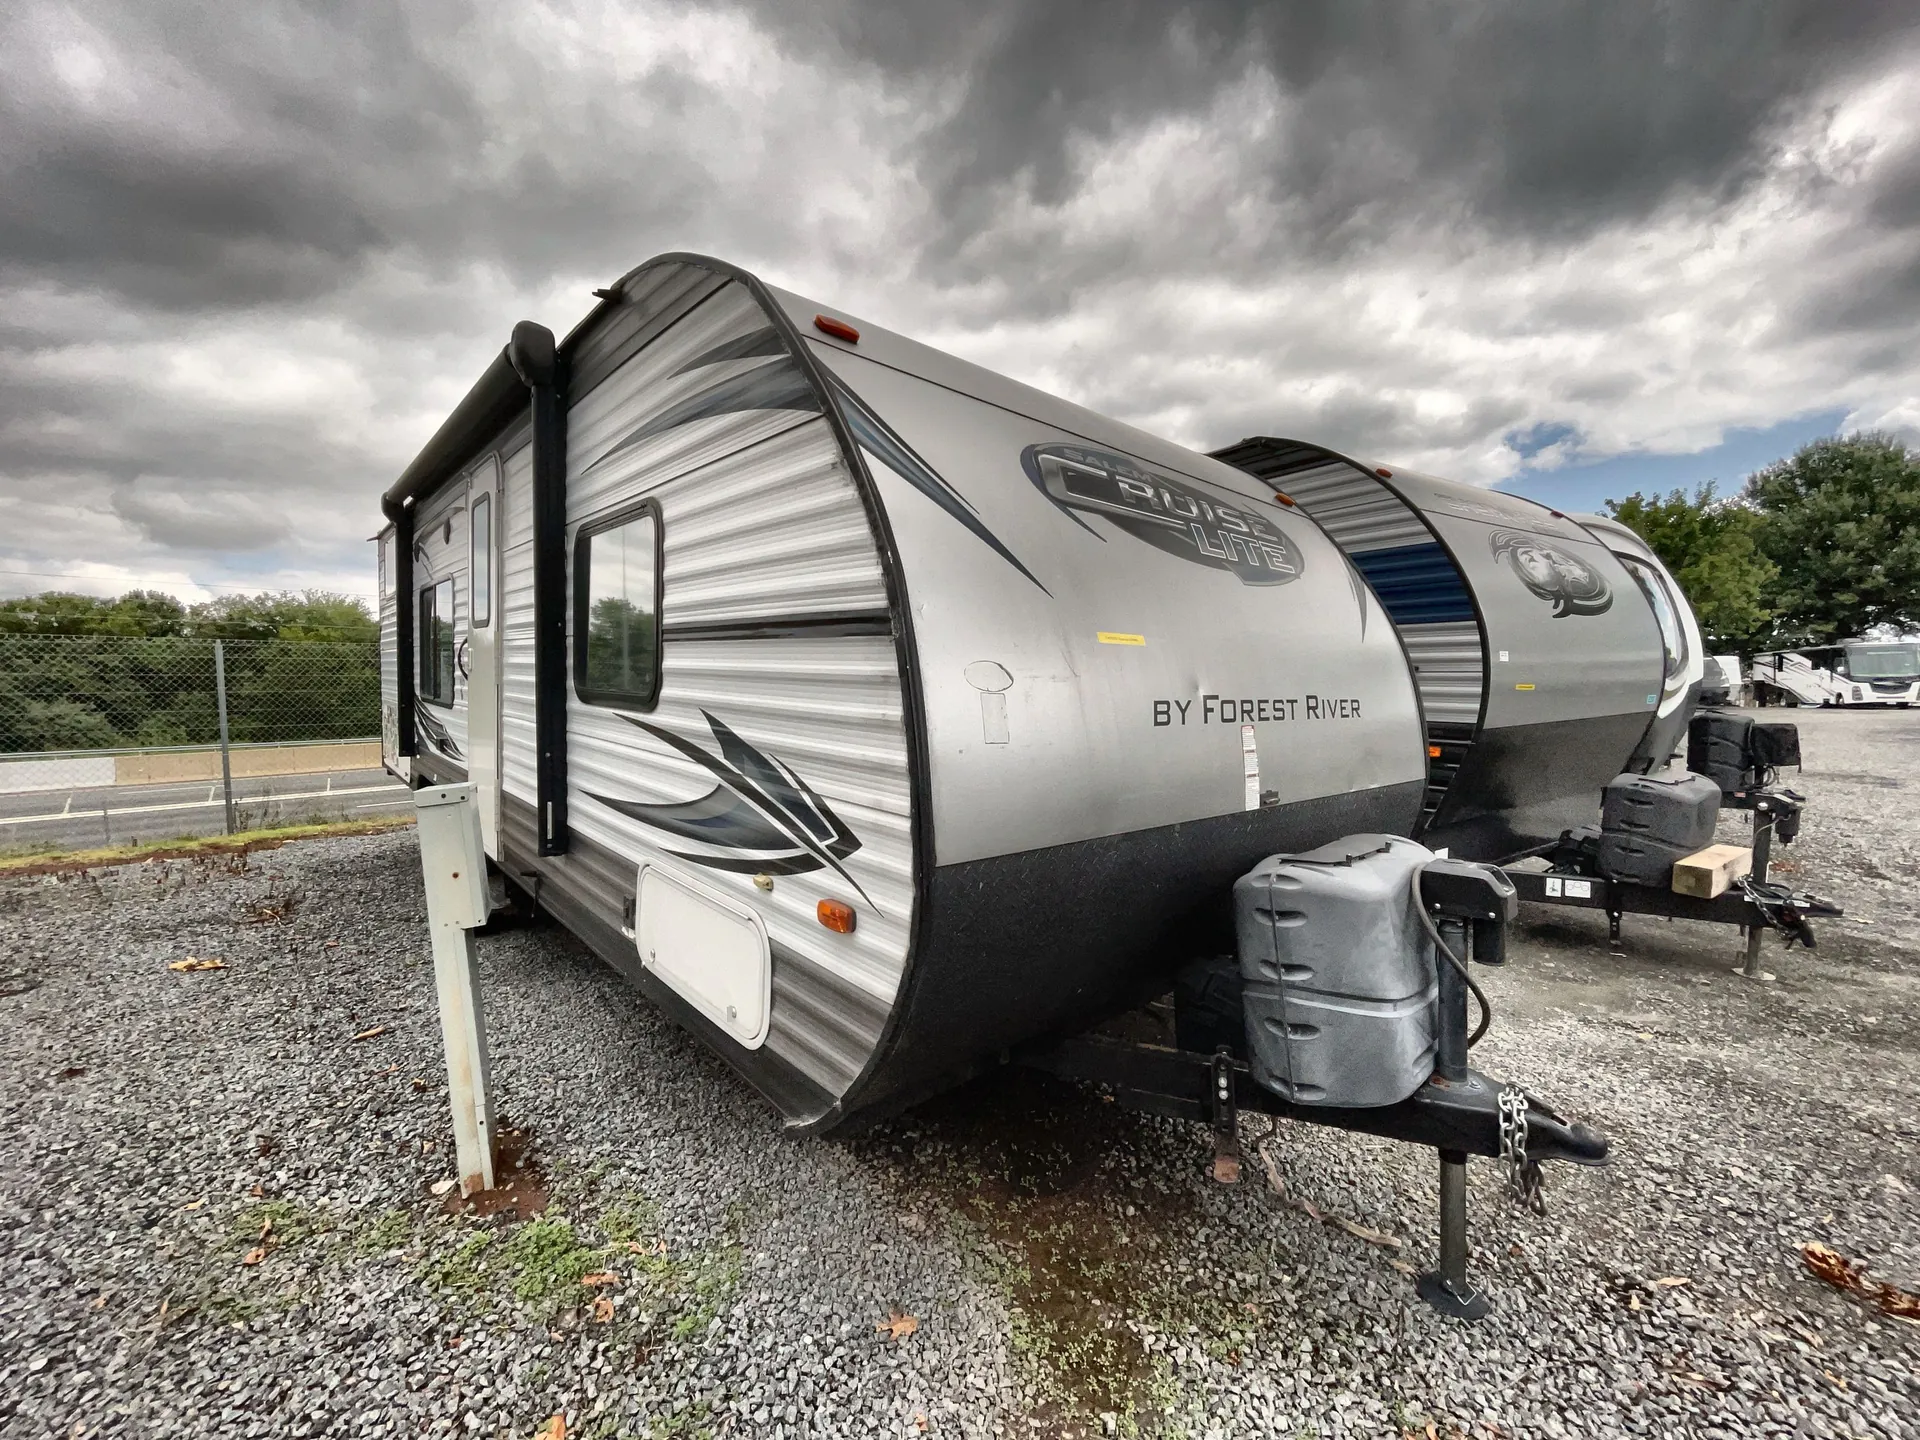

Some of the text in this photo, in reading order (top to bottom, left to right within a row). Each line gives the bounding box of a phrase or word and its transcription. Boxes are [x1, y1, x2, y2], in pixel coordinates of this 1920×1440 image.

[1063, 448, 1153, 483] SALEM
[1038, 453, 1279, 542] CRUISE
[1190, 523, 1296, 574] LITE
[1153, 695, 1361, 726] BY FOREST RIVER
